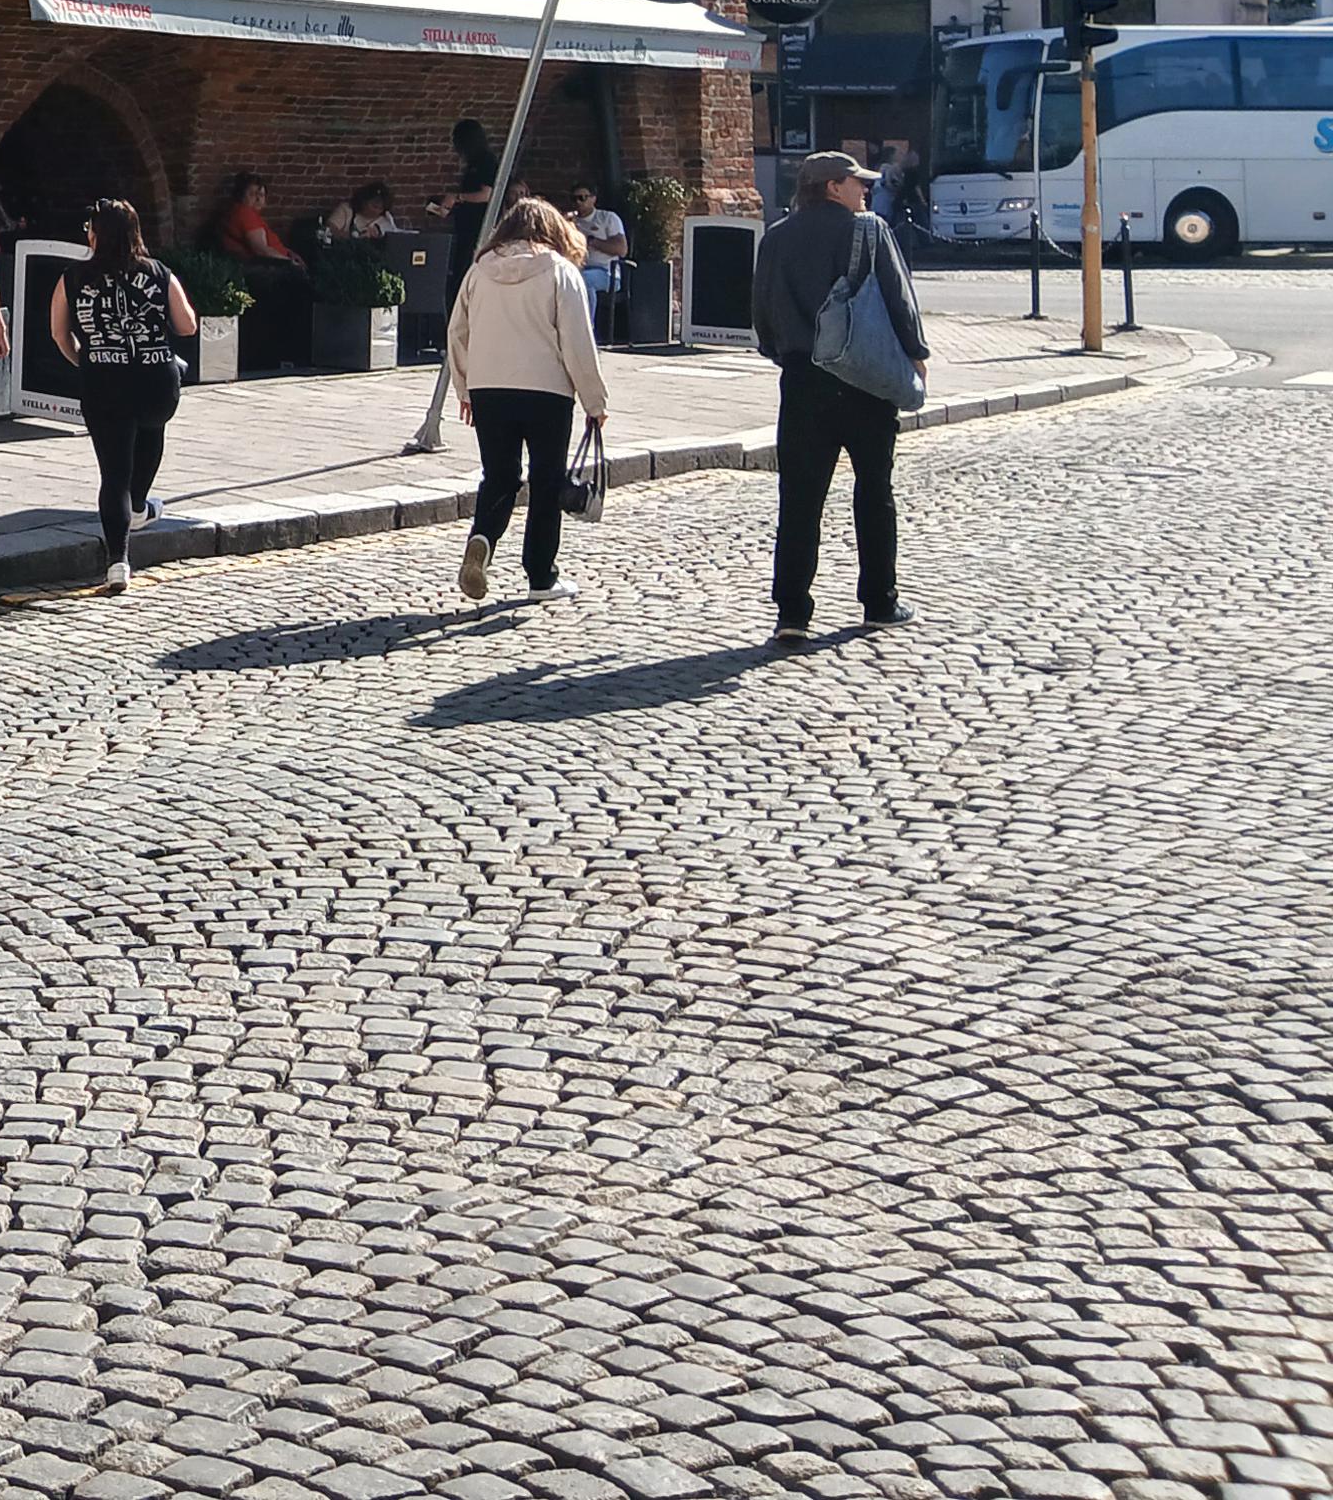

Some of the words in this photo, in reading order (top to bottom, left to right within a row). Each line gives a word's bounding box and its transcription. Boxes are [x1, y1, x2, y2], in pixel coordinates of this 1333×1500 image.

[422, 28, 454, 43] STELLA
[466, 30, 499, 45] ARTOIS
[142, 350, 172, 364] 2012
[22, 399, 51, 411] STELLA
[59, 406, 82, 416] ARTO
